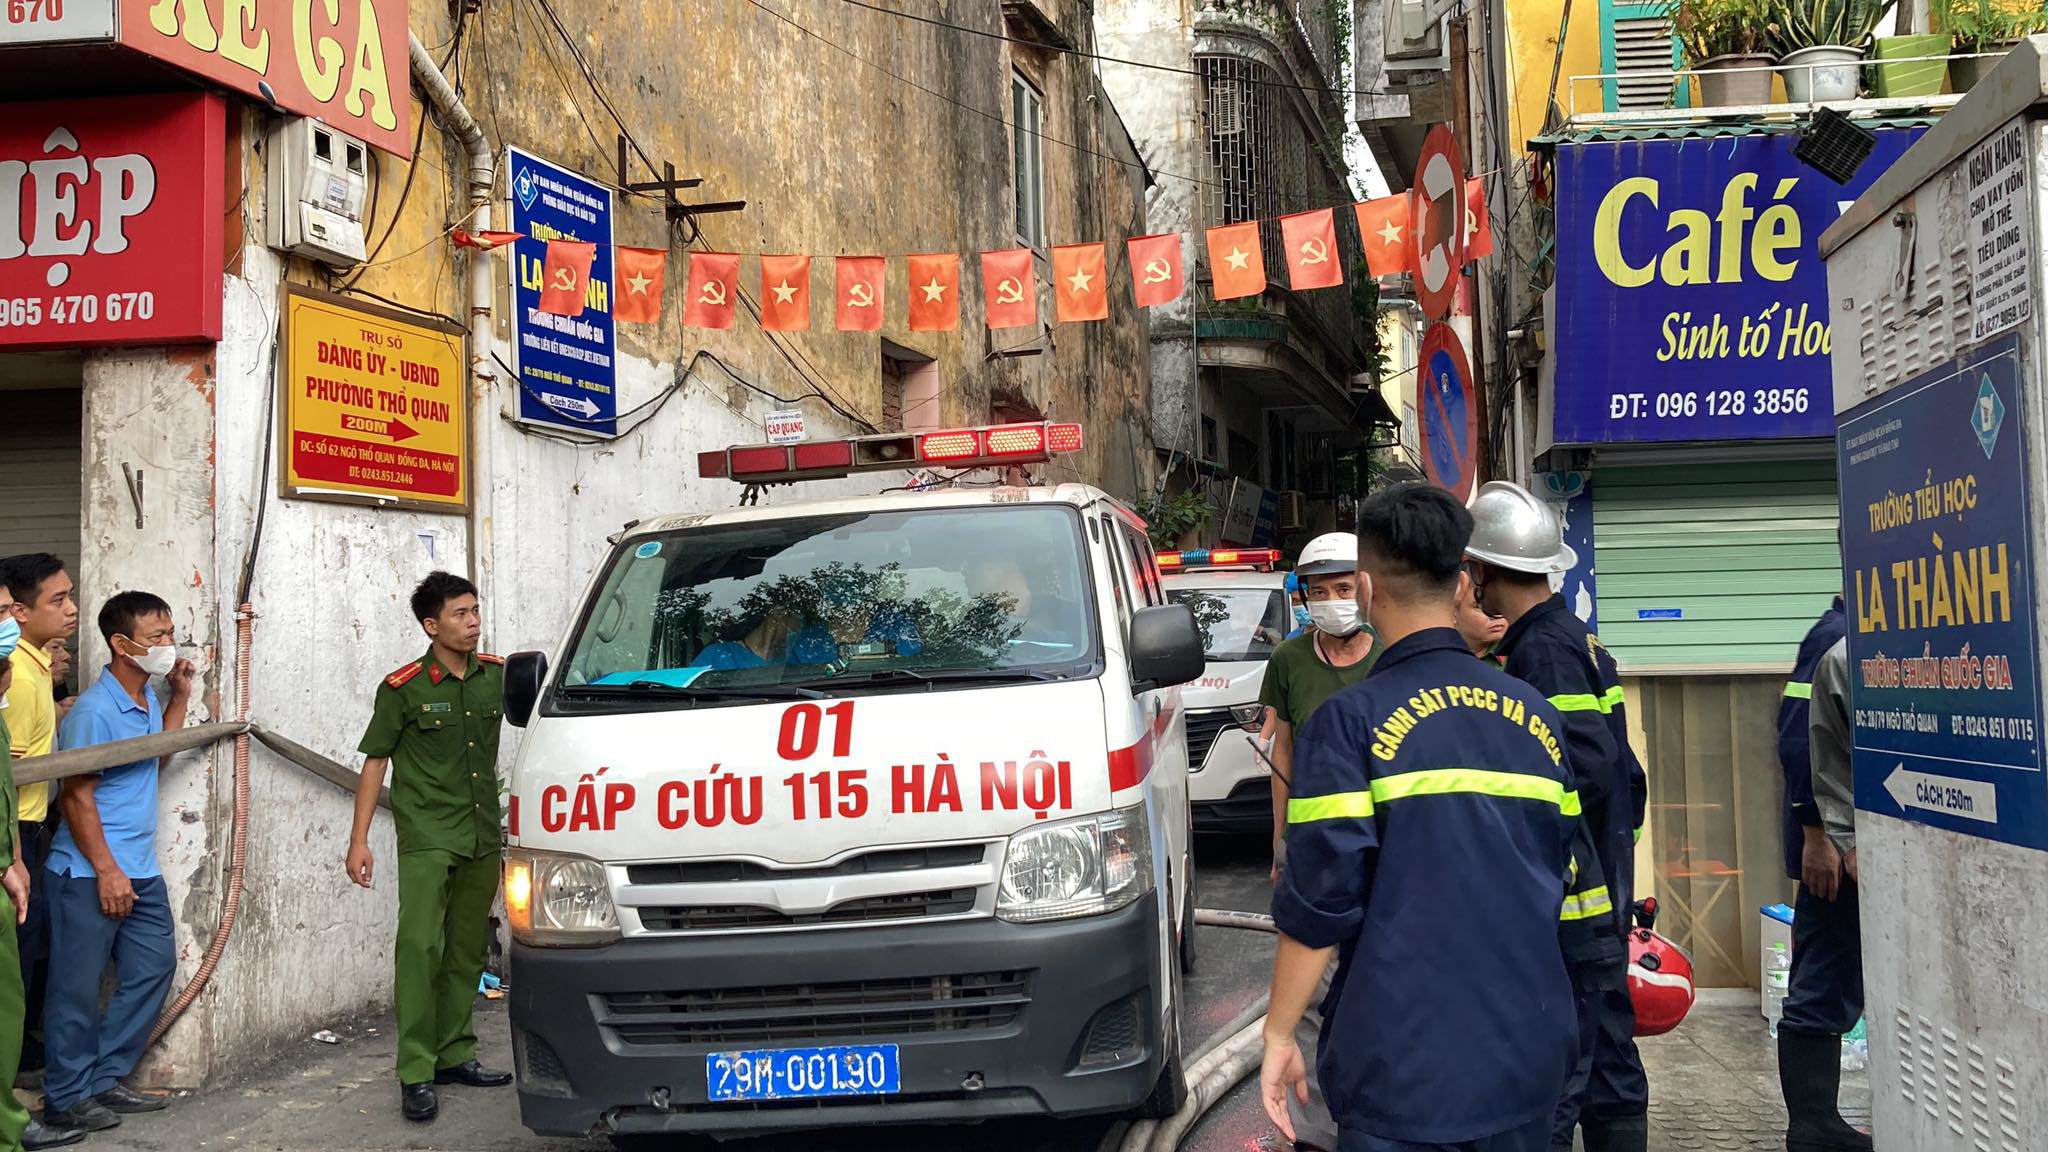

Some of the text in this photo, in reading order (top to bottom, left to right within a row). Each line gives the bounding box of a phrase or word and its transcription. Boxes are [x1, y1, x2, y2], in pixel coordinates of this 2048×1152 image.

[7, 0, 63, 24] 670
[293, 0, 398, 131] GA
[1969, 126, 2021, 192] NGÂN HÀNG
[1970, 167, 2023, 219] CHO VAY VỐN
[1593, 172, 1802, 288] Café
[1977, 226, 2020, 265] TIÊU DÙNG
[521, 253, 544, 293] LA
[50, 294, 98, 324] 470
[106, 291, 154, 321] 670
[360, 329, 403, 350] TRỤ SỞ
[1656, 311, 1730, 362] Sinh
[1737, 302, 1781, 358] tố
[317, 338, 362, 371] ĐẢNG
[367, 347, 387, 376] ỦY
[400, 360, 440, 388] UBND
[306, 375, 449, 423] PHƯỜNG THỔ QUAN
[567, 399, 585, 411] 250m
[1610, 388, 1809, 419] ĐT: 096 128 3856
[346, 416, 388, 435] 200M
[781, 422, 804, 436] QUANG
[316, 438, 327, 455] SỐ
[328, 444, 339, 457] 62
[375, 452, 395, 464] QUAN
[432, 456, 441, 471] HÀ
[1869, 468, 1977, 533] TRƯỜNG TIỂU HỌC
[1855, 531, 2011, 633] LA THÀNH
[1901, 640, 1941, 689] CHUẨN
[1942, 641, 1981, 689] QUỐC
[1983, 654, 2013, 690] GIA
[776, 700, 855, 761] 01
[1371, 706, 1418, 761] CẢNH
[1408, 688, 1448, 718] SÁT
[1445, 685, 1498, 712] PCCC
[1502, 696, 1525, 726] VÀ
[1917, 713, 1939, 734] QUAN
[1951, 714, 1965, 736] ĐT:
[1966, 716, 1987, 738] 0243
[1989, 716, 2005, 739] 851
[2008, 718, 2034, 741] 0115
[541, 750, 1072, 833] CẤP CỨU 115 HÀ NỘI
[1916, 778, 1974, 812] CÁCH 250m
